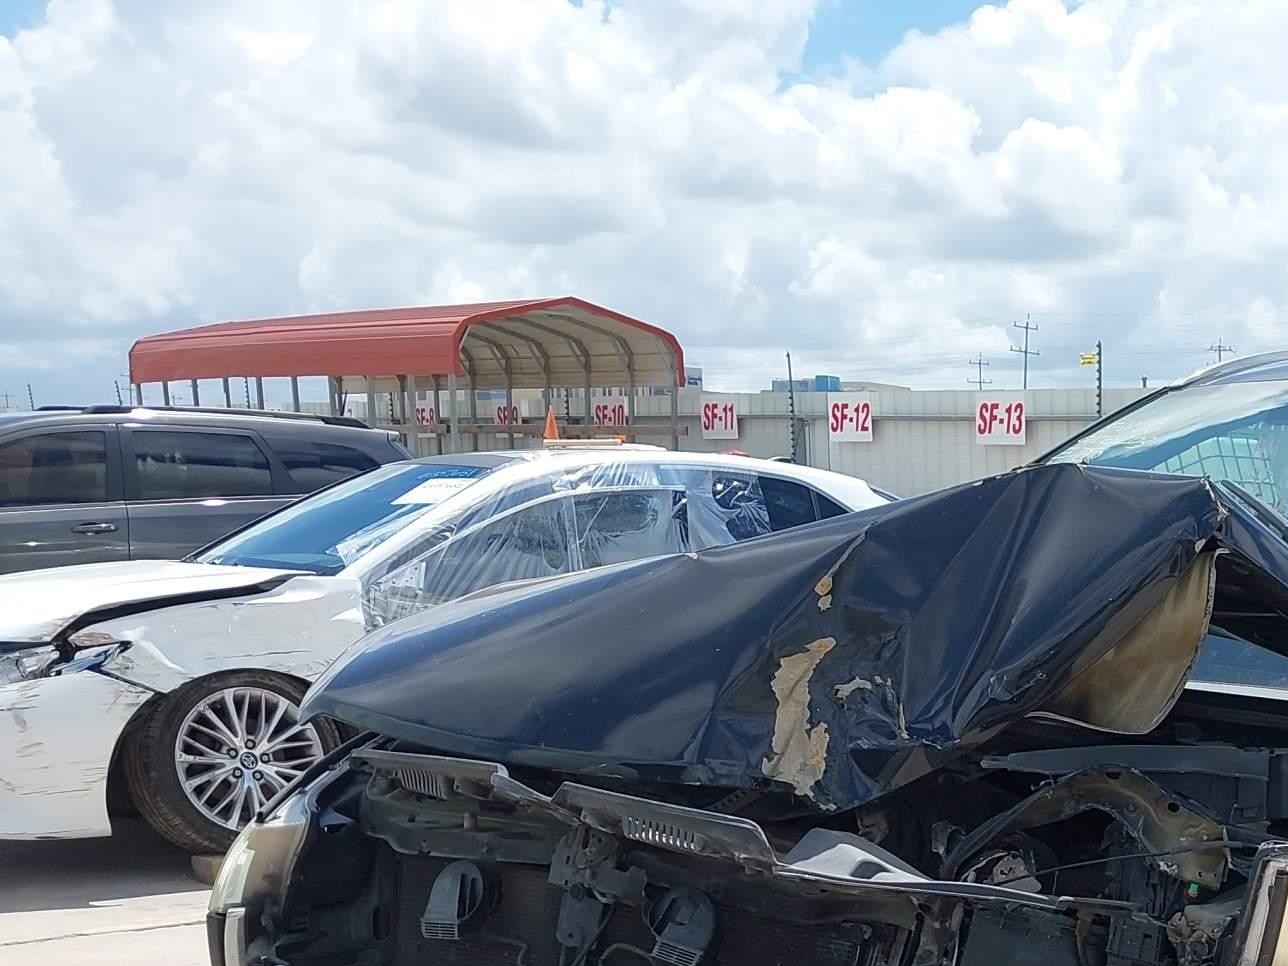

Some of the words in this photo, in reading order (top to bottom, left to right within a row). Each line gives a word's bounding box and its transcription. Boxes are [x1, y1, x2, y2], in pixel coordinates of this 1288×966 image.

[497, 405, 518, 424] SF9
[595, 404, 624, 425] SF-10
[703, 402, 734, 431] SF-11
[831, 402, 870, 432] SF-12
[977, 402, 1024, 435] SF-13
